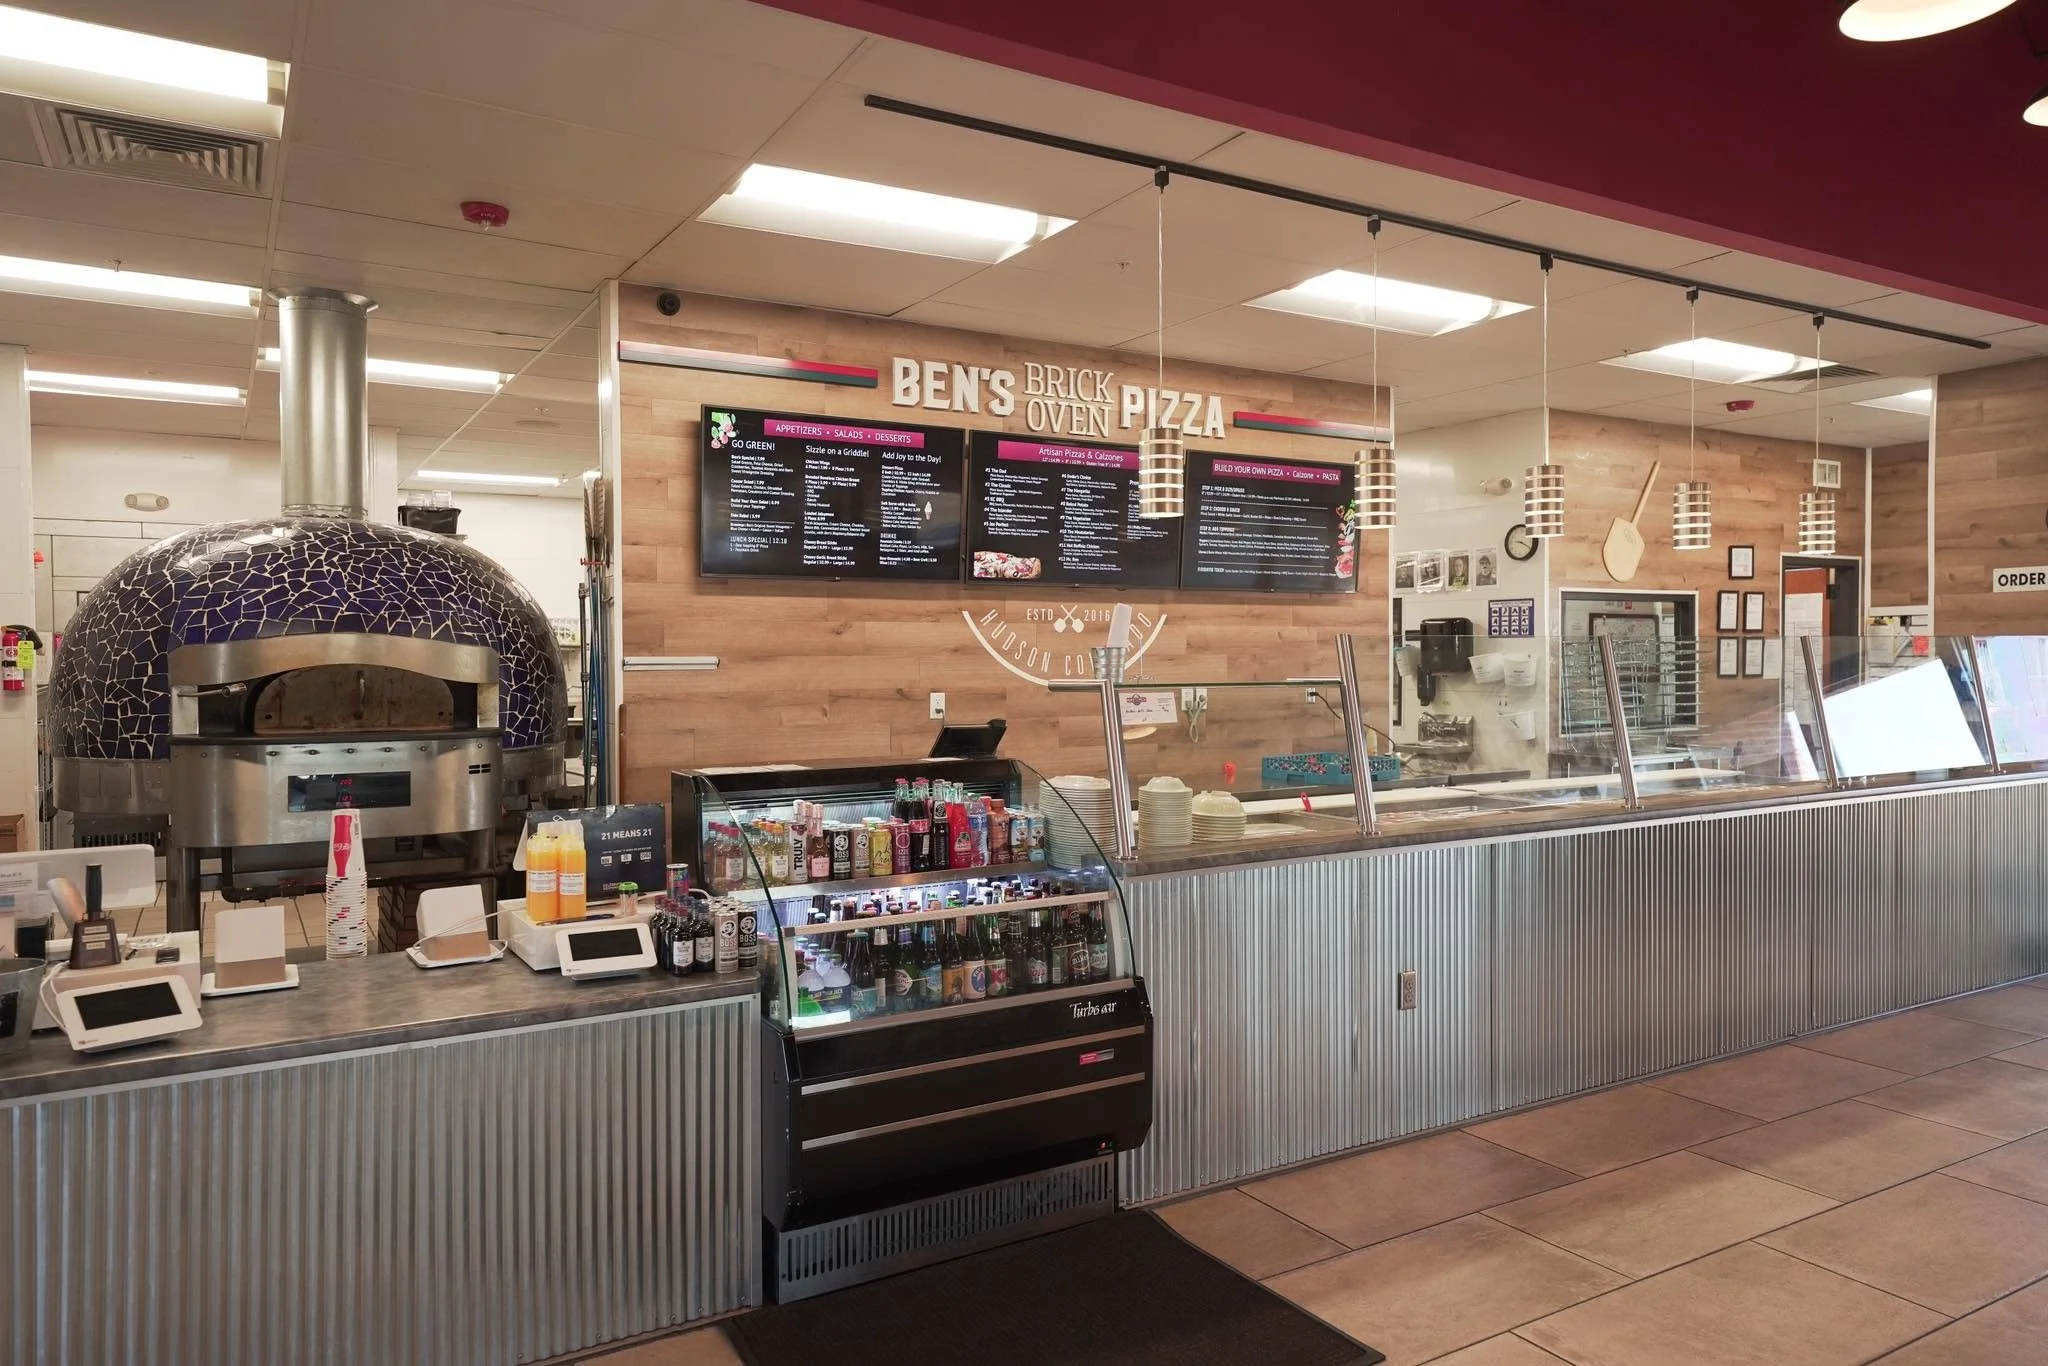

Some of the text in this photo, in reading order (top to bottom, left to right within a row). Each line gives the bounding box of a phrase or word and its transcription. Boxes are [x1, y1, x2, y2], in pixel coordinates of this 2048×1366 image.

[892, 357, 1016, 416] BEN'S
[1024, 361, 1114, 404] BRICK
[1026, 397, 1112, 438] OVEN
[1120, 384, 1226, 438] PIZZA
[776, 423, 911, 444] APPETIZERS SALADS DESSERTS
[731, 440, 775, 451] GO GREEN!
[805, 445, 826, 454] Sizzle
[843, 449, 870, 457] Griddle!
[881, 451, 895, 459] Add
[895, 453, 906, 462] Joy
[927, 455, 942, 464] Day!
[1039, 448, 1124, 462] Artisan Pizzas & Calzones
[1214, 464, 1339, 481] BUILD YOUR OWN PIZZA Calzone PASTA
[1998, 572, 2046, 587] ORDER
[1026, 608, 1054, 621] ESTD
[1084, 609, 1111, 622] 2016
[980, 608, 1051, 673] HUDSON
[601, 828, 652, 840] 21 MEANS 21
[794, 839, 803, 870] TRULY
[720, 938, 737, 947] BOSS
[740, 934, 757, 942] BOSS
[1069, 1001, 1117, 1019] Turbo air
